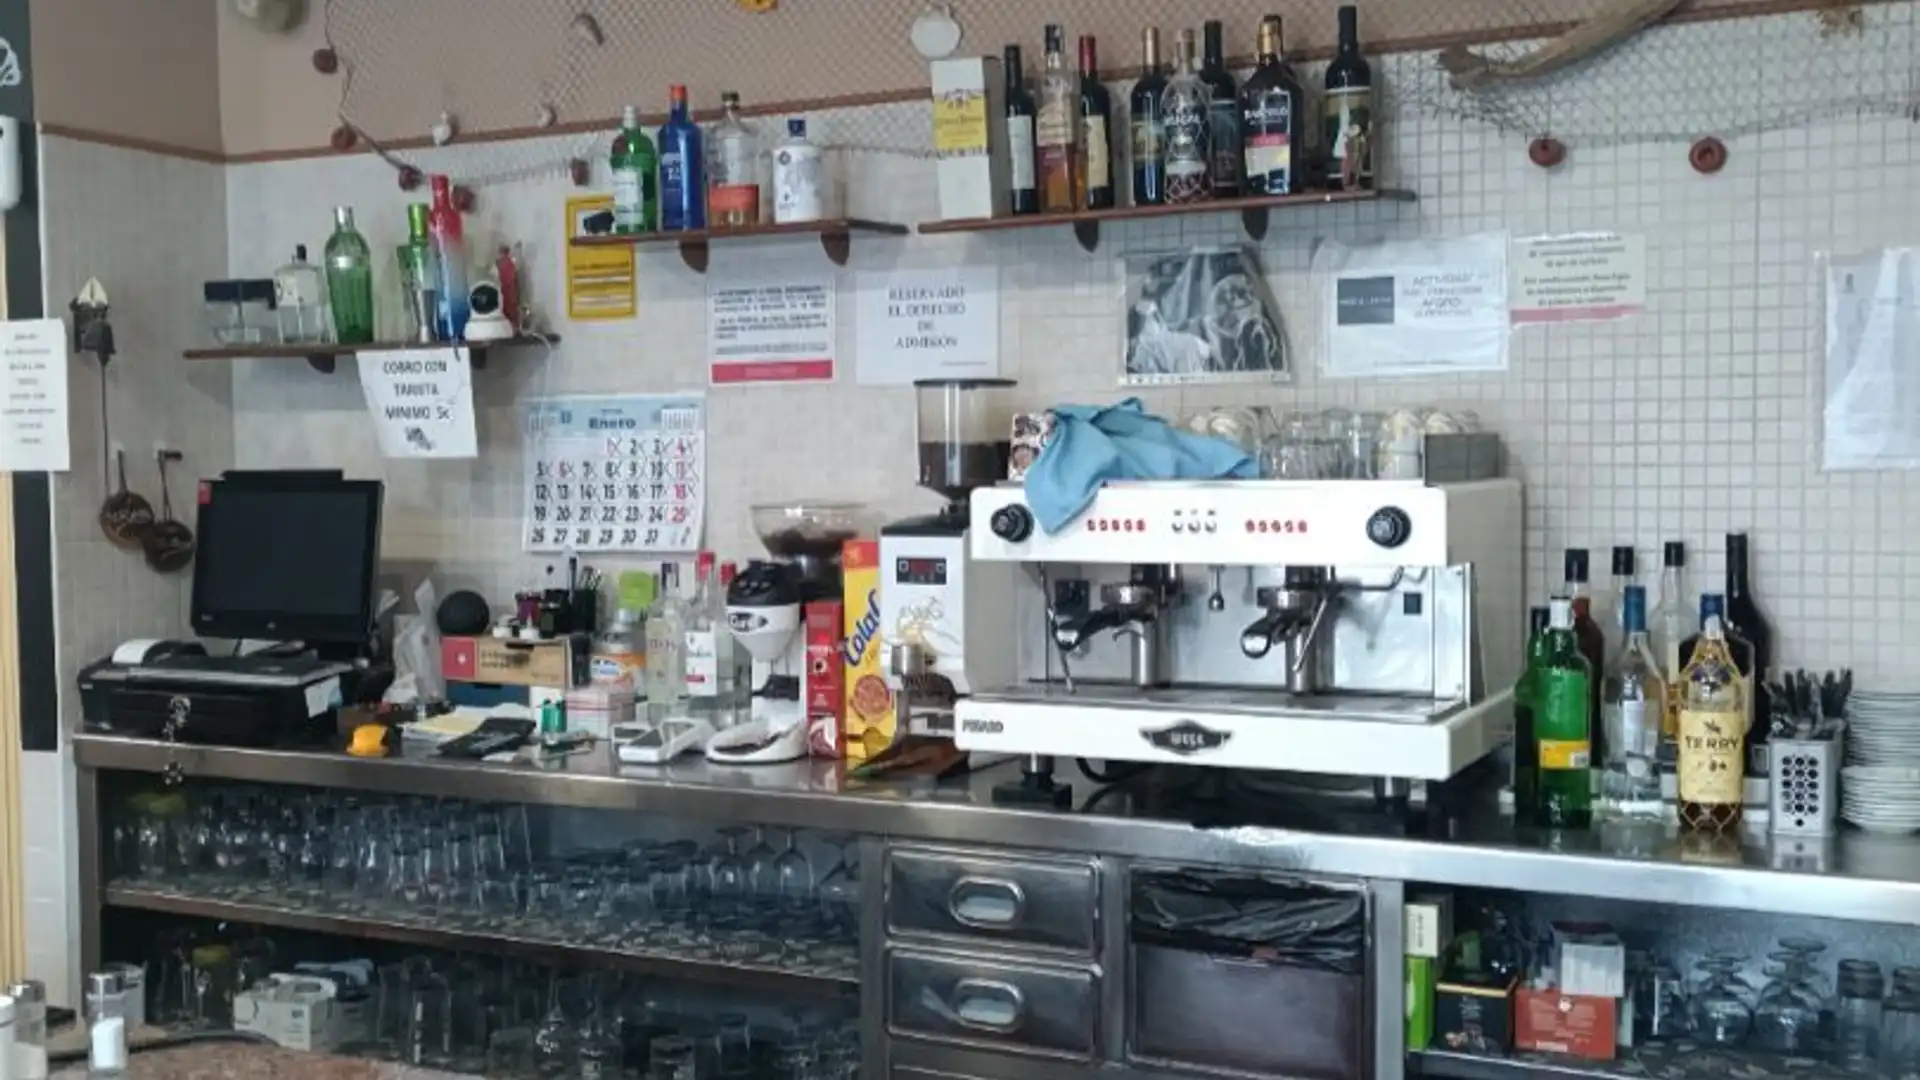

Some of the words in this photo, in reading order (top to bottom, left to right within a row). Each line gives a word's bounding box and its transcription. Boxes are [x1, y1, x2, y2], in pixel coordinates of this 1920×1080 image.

[888, 286, 965, 301] RESERVADO
[888, 304, 906, 318] EL
[906, 303, 966, 318] DERECHO
[917, 320, 935, 332] DE
[383, 360, 423, 375] COBRO
[424, 360, 448, 372] CON
[588, 416, 637, 430] Enero
[535, 484, 547, 500] 12
[557, 484, 569, 500] 13
[580, 484, 592, 500] 14
[603, 484, 615, 500] 15
[627, 484, 640, 500] 16
[650, 484, 663, 500] 17
[533, 505, 546, 521] 19
[556, 506, 570, 521] 20
[579, 506, 592, 521] 21
[602, 506, 616, 521] 22
[625, 506, 639, 521] 23
[649, 506, 663, 522] 24
[531, 527, 545, 543] 26
[553, 527, 568, 544] 27
[575, 528, 591, 544] 28
[599, 528, 614, 544] 29
[621, 528, 637, 545] 30
[644, 528, 659, 545] 31
[1685, 735, 1739, 750] TERRY
